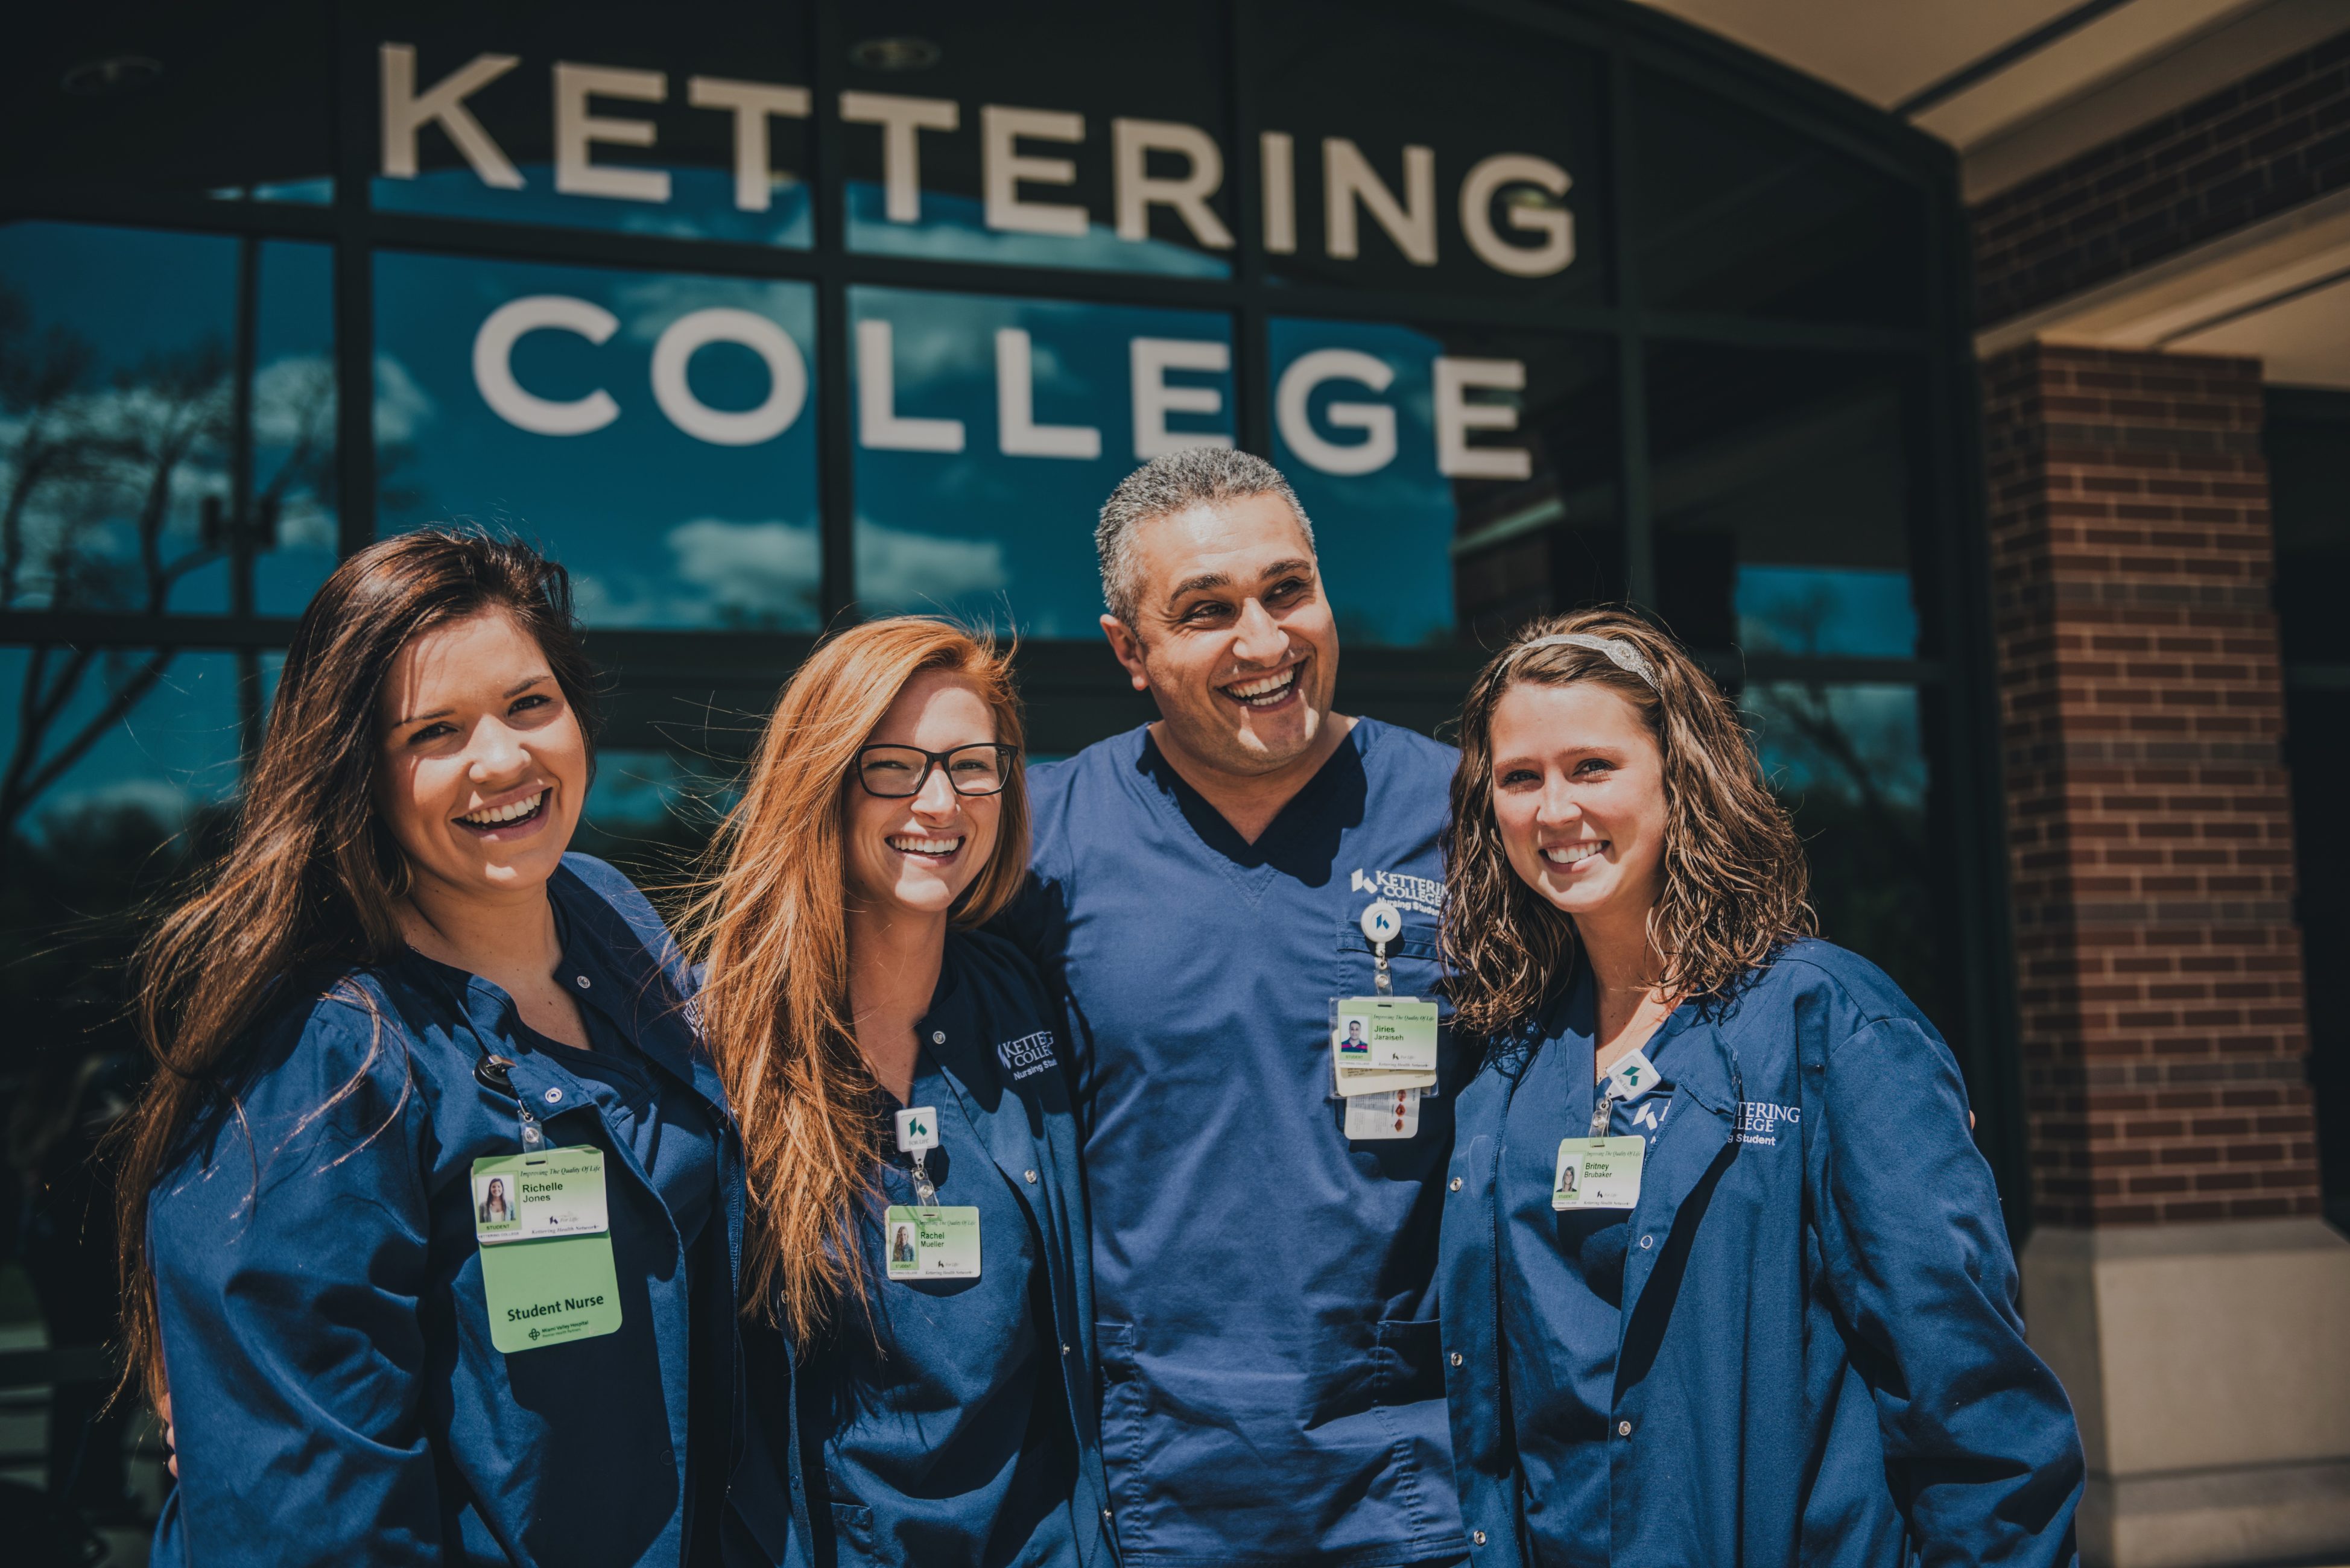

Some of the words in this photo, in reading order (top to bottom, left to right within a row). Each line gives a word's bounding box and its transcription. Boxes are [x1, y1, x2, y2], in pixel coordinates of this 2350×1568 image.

[379, 42, 1575, 277] KETTERING
[472, 294, 1530, 478] COLLEGE
[1375, 870, 1449, 897] KETTERIN
[1376, 897, 1412, 911] Nursing
[1382, 885, 1442, 906] COLLEGE
[1013, 1064, 1044, 1081] Nursing
[1736, 1133, 1776, 1146] Student
[1585, 1162, 1609, 1171] Britney
[522, 1182, 563, 1193] Richelle
[523, 1193, 551, 1203] Jones
[507, 1301, 562, 1322] Student
[565, 1295, 604, 1311] Nurse
